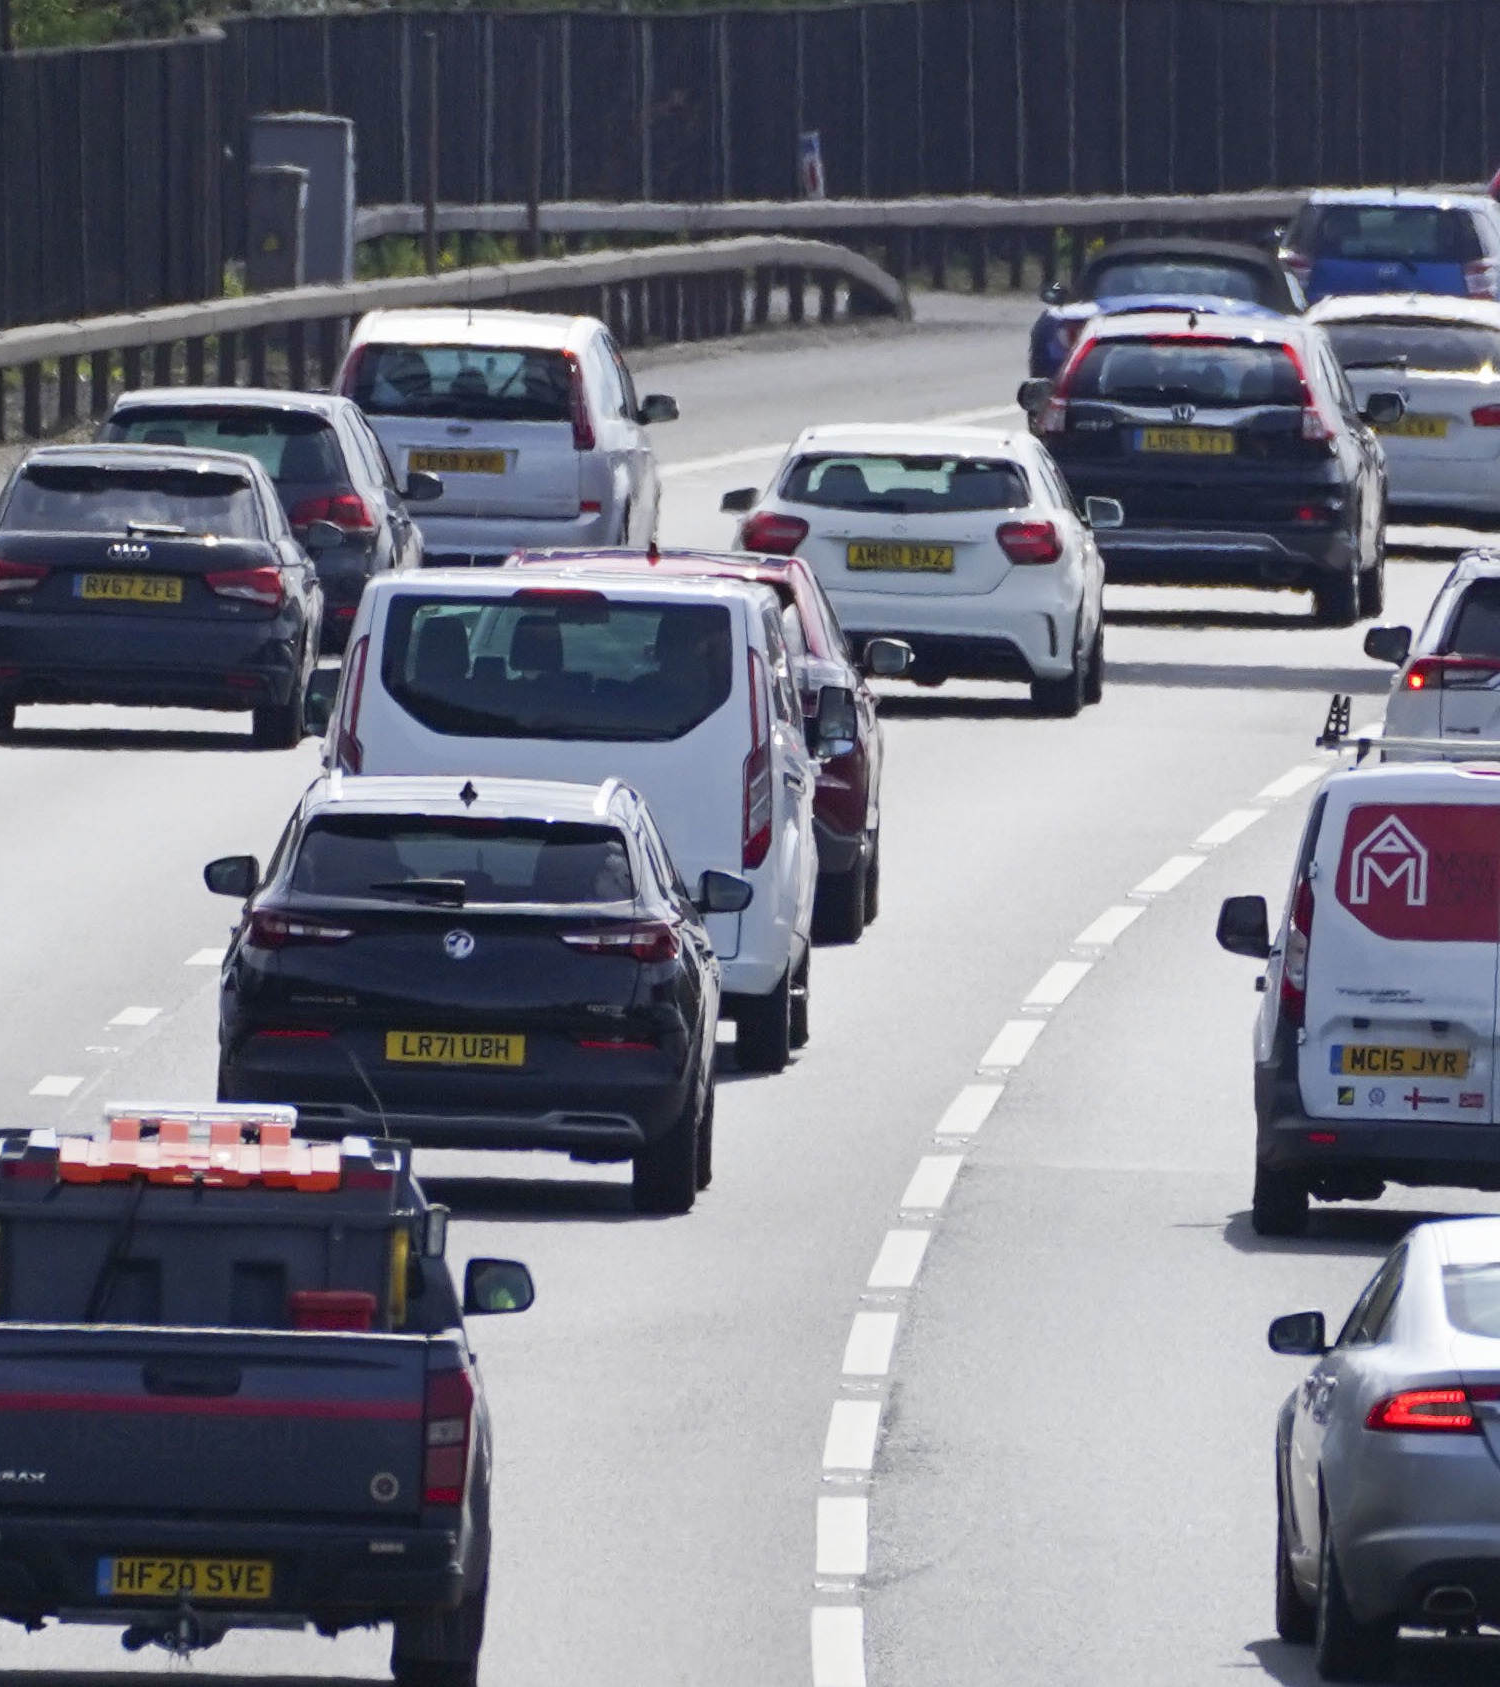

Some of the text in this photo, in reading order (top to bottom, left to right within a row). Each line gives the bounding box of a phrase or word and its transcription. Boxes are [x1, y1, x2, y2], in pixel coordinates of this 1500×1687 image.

[402, 1036, 510, 1059] LR71 UBH
[1352, 1050, 1458, 1073] MC15 JYR
[116, 1563, 265, 1594] HF20 SVE
